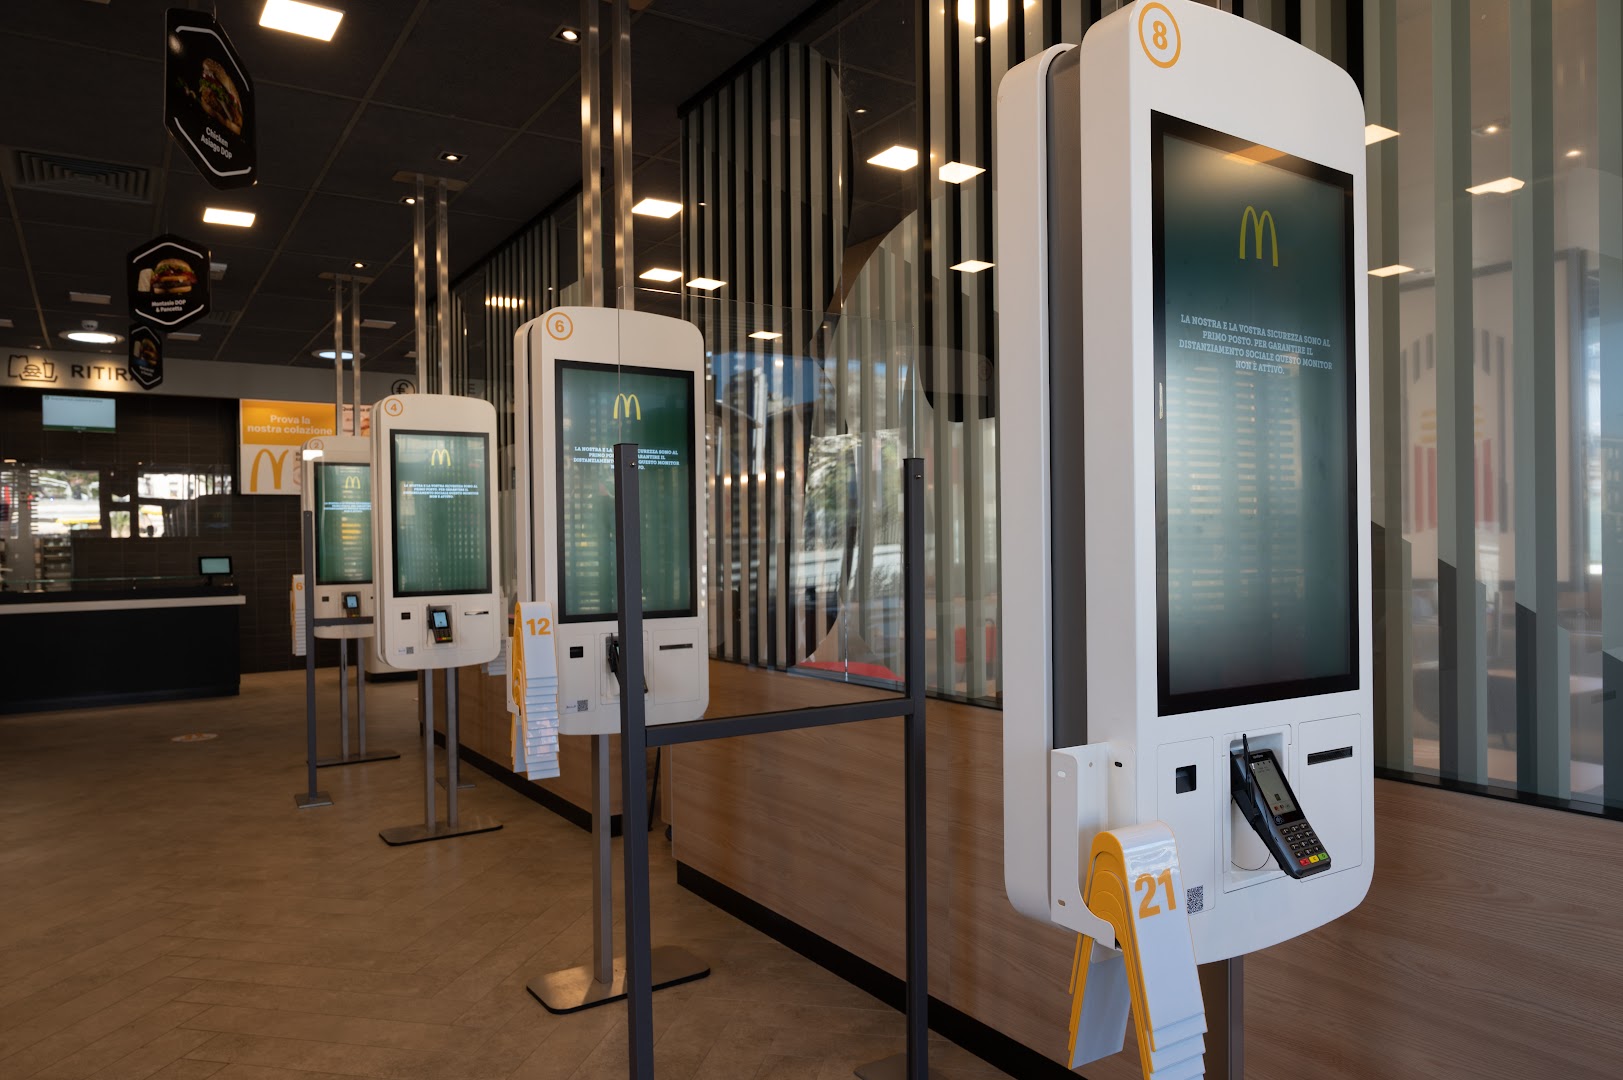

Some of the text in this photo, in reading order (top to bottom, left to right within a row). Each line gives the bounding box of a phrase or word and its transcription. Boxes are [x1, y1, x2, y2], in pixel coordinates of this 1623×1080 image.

[1152, 20, 1168, 50] 8
[206, 126, 228, 148] Chicken
[200, 134, 232, 160] Asiago DOP
[554, 320, 565, 333] 6
[1180, 314, 1331, 347] LA NOSTRA E LA VOSTRA SICUREZZA SONO AL
[1202, 330, 1227, 342] PRIMO
[1254, 338, 1268, 349] PER
[1268, 341, 1306, 355] GARANTIRE
[1306, 347, 1314, 356] IL
[1179, 339, 1333, 370] DISTANZIAMENTO SOCIALE QUESTO MONITOR
[71, 364, 134, 381] RITIR
[1235, 360, 1285, 374] NON È ATTIVO.
[390, 404, 397, 412] 4
[270, 415, 300, 424] Prova
[247, 424, 332, 436] nostra colazione
[295, 582, 303, 590] 6
[526, 617, 552, 636] 12
[1134, 867, 1177, 919] 21
